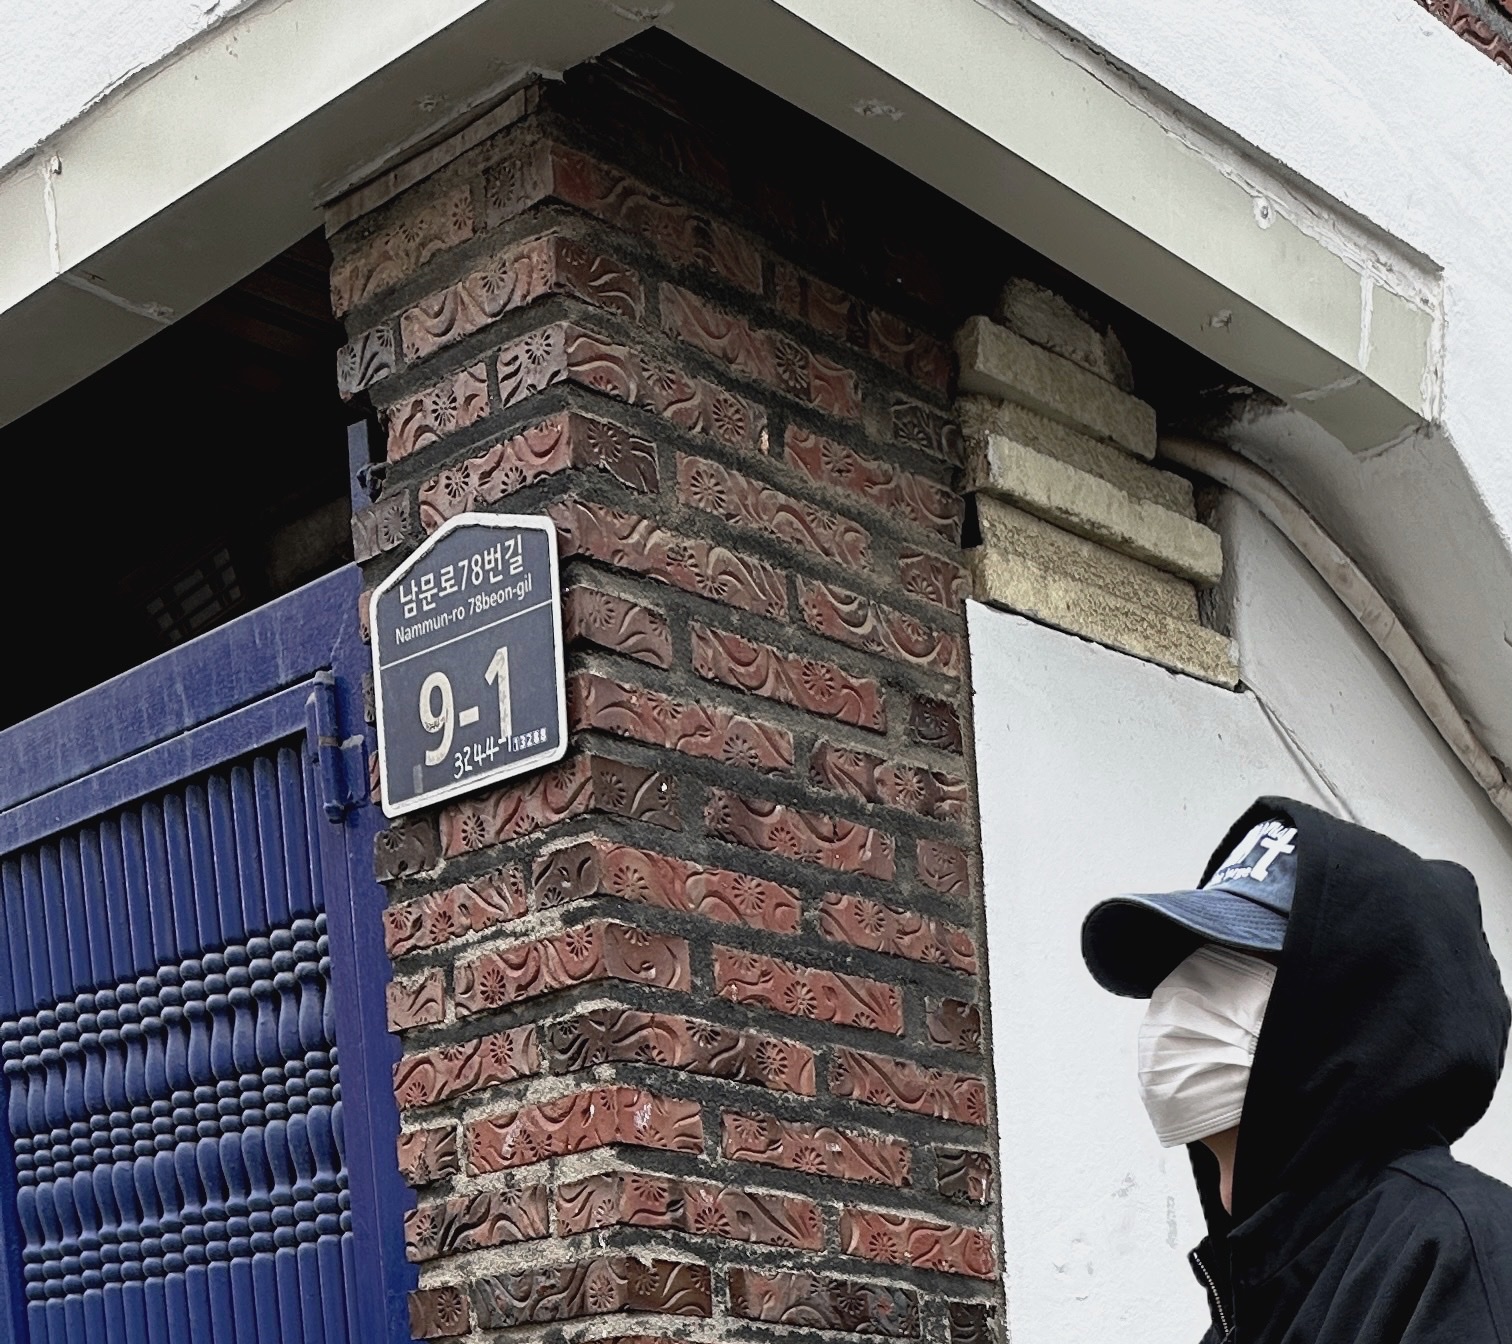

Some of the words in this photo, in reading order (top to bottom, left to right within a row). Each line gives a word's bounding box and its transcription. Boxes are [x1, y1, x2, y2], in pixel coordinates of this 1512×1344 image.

[395, 606, 465, 645] Nammun-ro
[467, 572, 533, 616] 78beon-gil
[399, 534, 524, 619] 남문로78번길
[418, 645, 513, 767] 9-1
